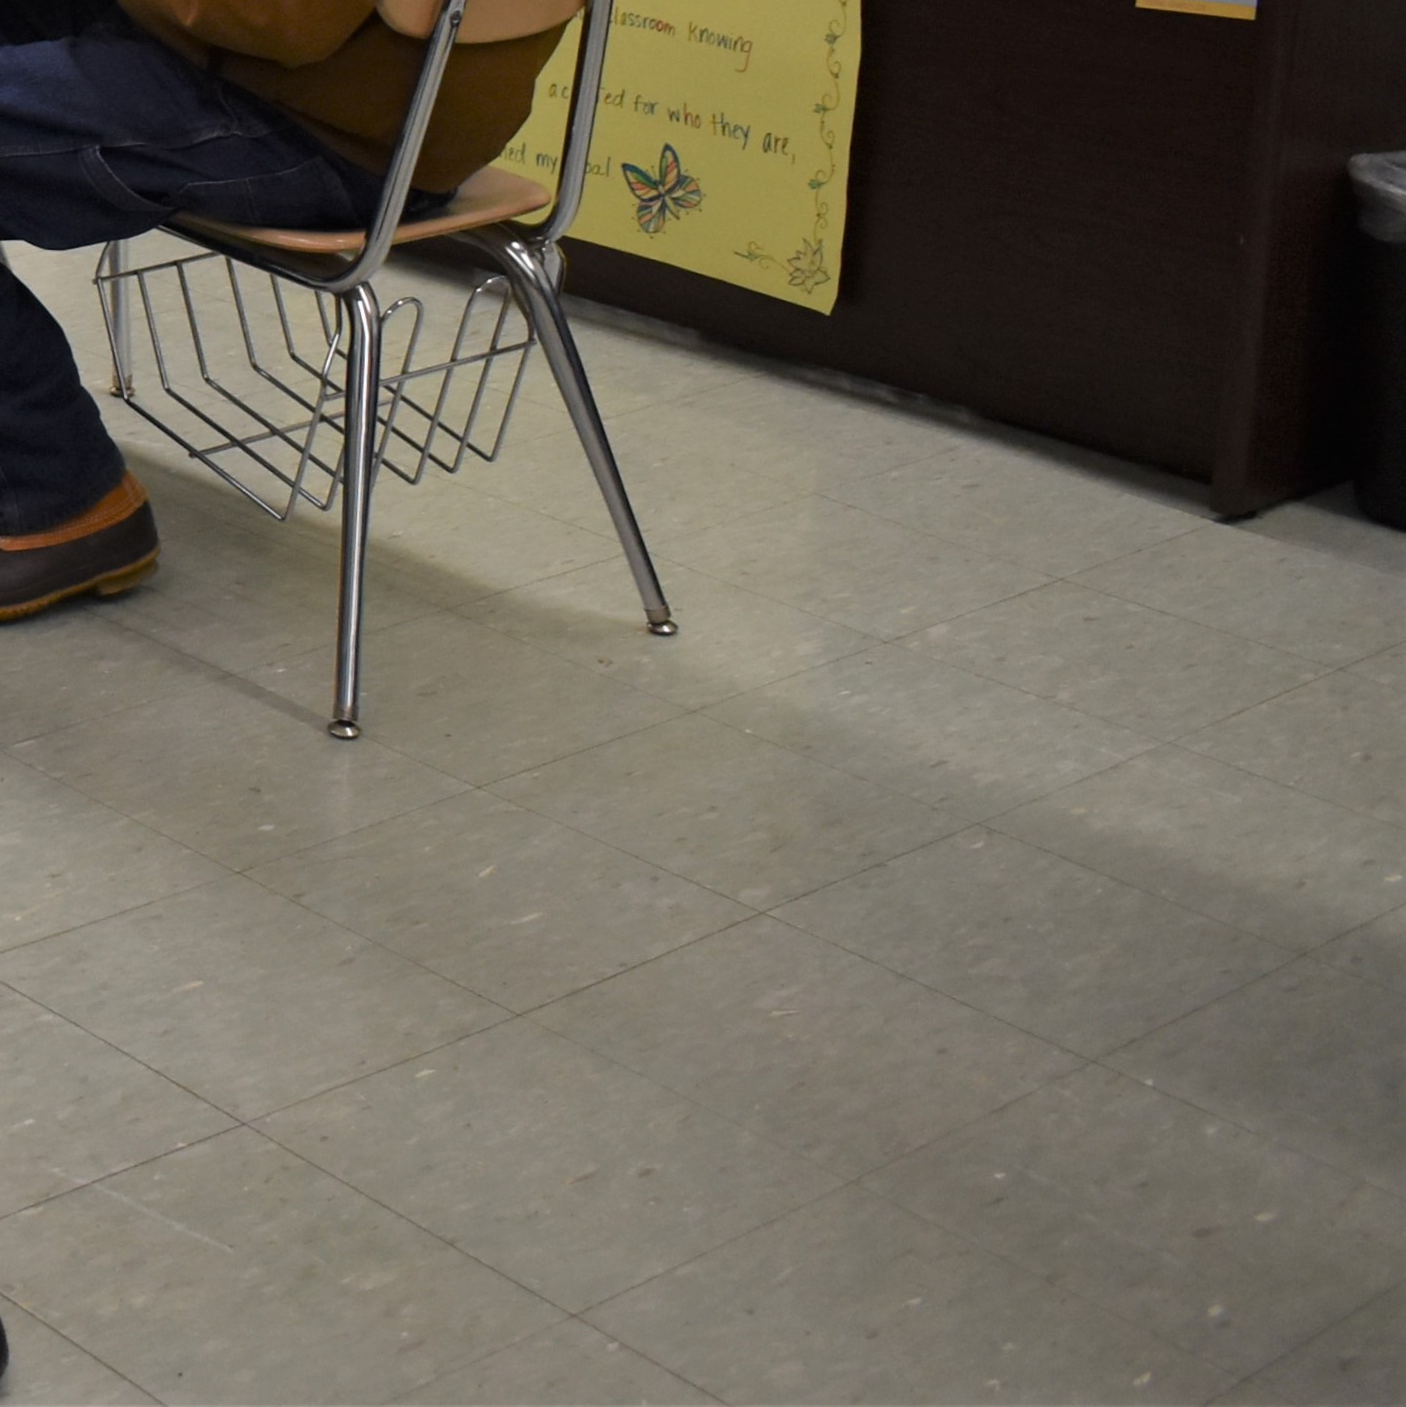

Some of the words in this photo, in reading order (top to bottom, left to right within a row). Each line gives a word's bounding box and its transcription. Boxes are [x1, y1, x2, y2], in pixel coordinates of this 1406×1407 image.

[688, 21, 754, 73] Knowing
[633, 94, 658, 115] for
[668, 102, 701, 129] who
[712, 111, 751, 151] they
[536, 152, 558, 174] my
[585, 156, 612, 177] oal
